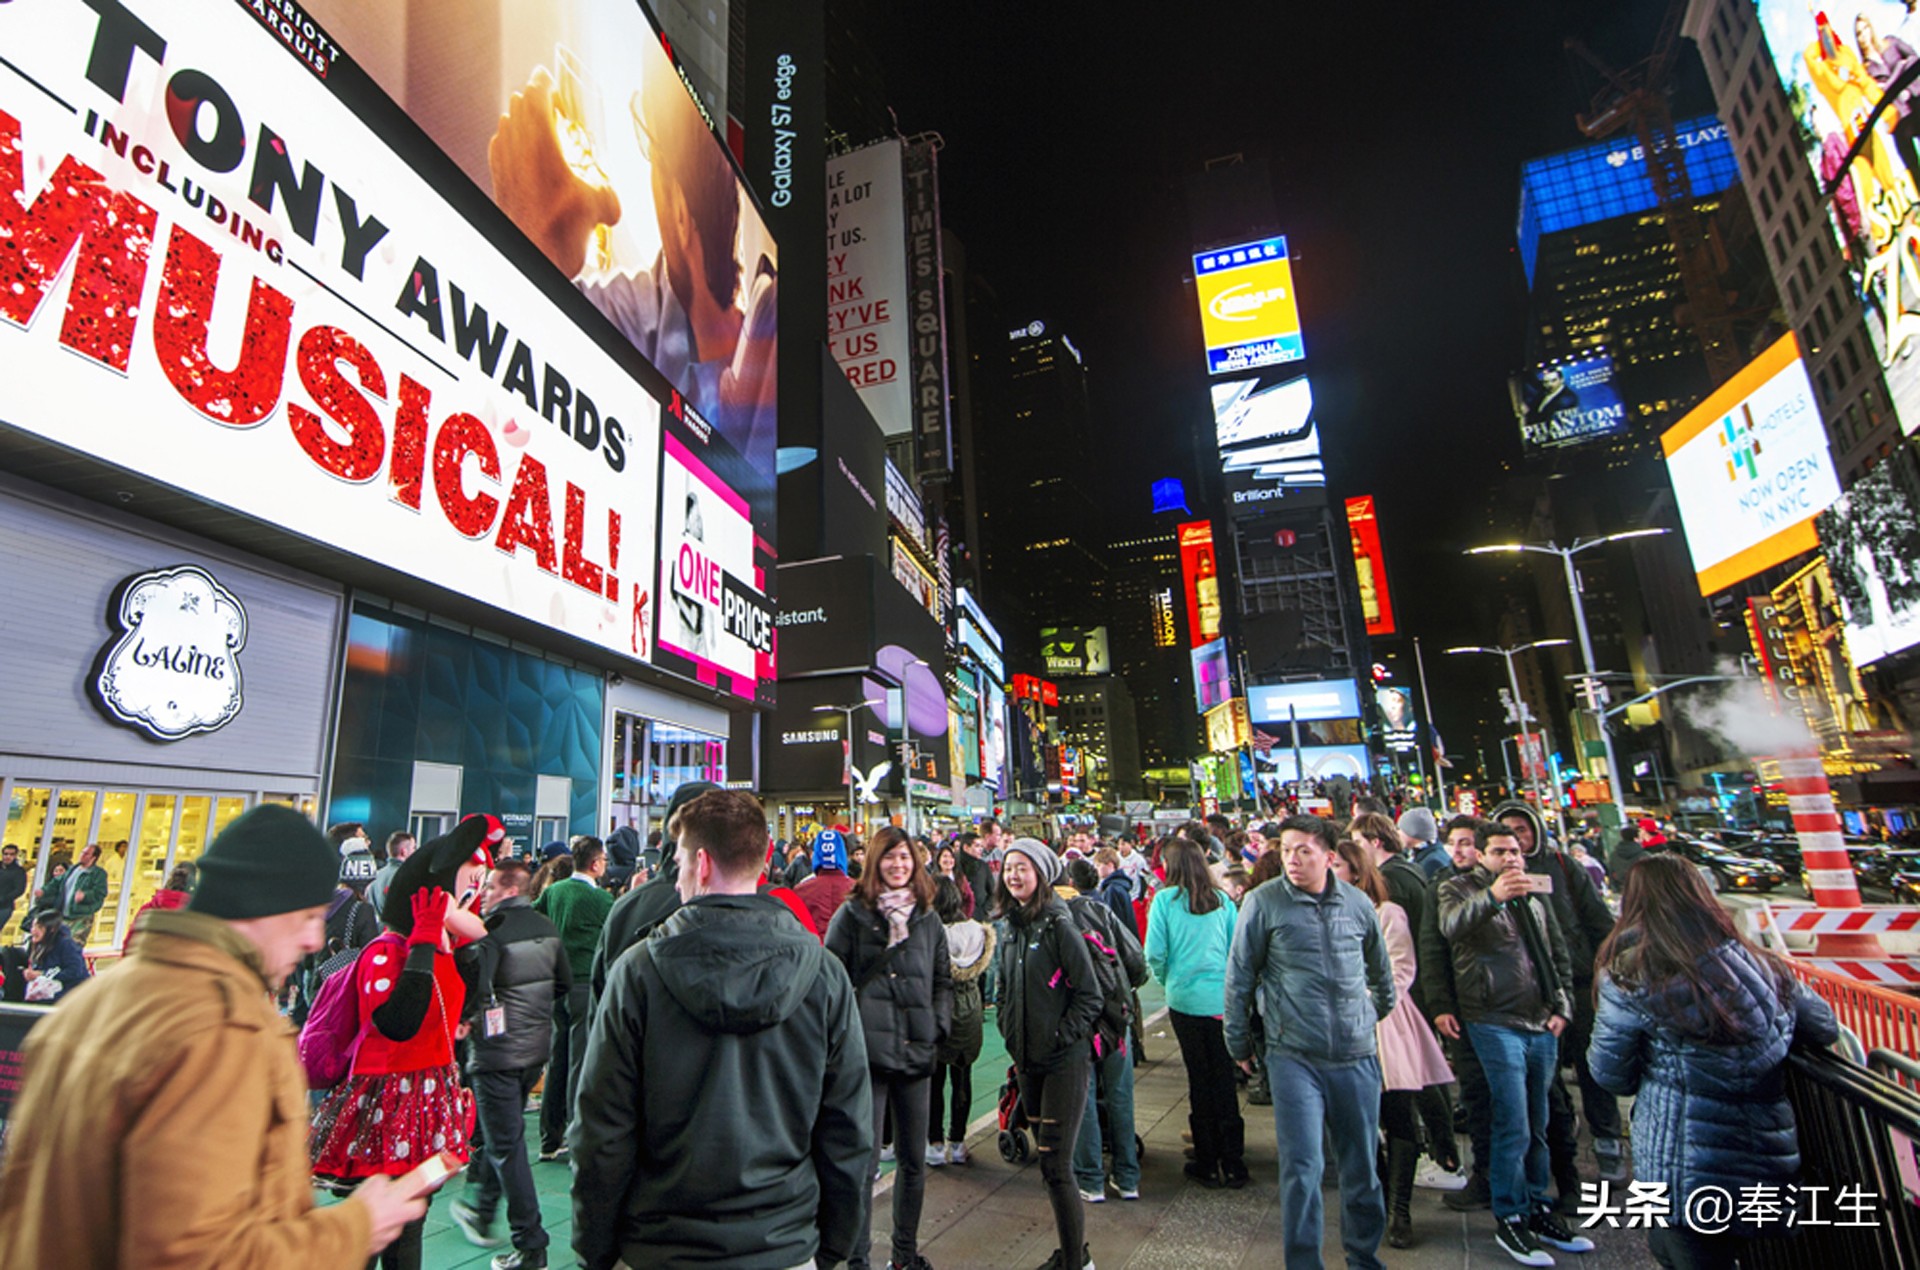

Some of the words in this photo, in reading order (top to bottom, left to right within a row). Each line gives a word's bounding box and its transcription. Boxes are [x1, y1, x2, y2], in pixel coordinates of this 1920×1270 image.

[247, 0, 325, 72] ARQUIS
[777, 54, 797, 101] edge
[771, 102, 793, 126] S7
[83, 108, 287, 267] INCLUDING
[771, 128, 797, 208] Galaxy
[845, 181, 872, 204] LOT
[85, 0, 390, 283] TONY
[395, 255, 626, 474] AWARDS
[827, 212, 839, 230] Y
[841, 227, 867, 247] US.
[909, 169, 935, 277] TIMES
[846, 331, 878, 357] US
[915, 289, 940, 434] SQUARE
[1522, 403, 1624, 440] PHANTOM
[1739, 479, 1773, 514] NOW
[1775, 452, 1820, 492] OPEN
[1777, 486, 1811, 516] NYC
[679, 543, 721, 607] ONE
[723, 586, 772, 653] PRICE
[1160, 587, 1177, 647] NOVOTEL
[782, 729, 839, 744] SAMSUNG
